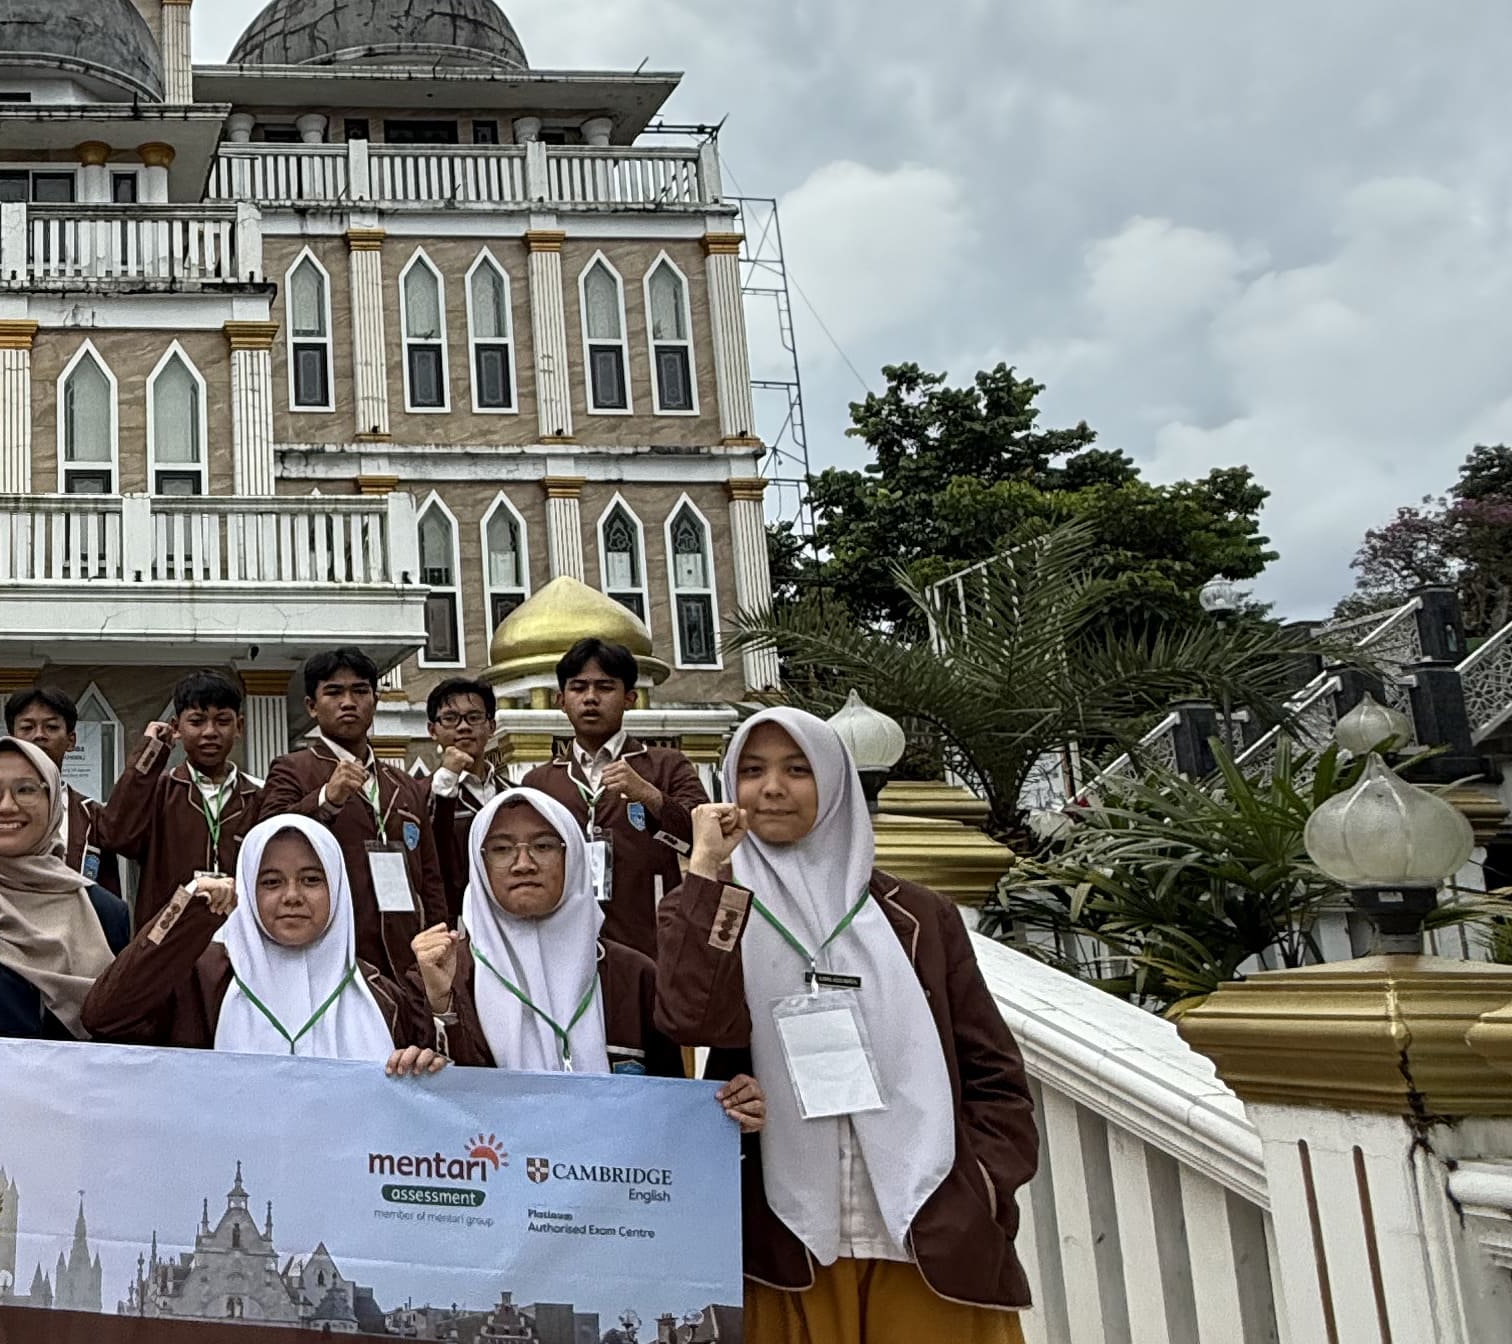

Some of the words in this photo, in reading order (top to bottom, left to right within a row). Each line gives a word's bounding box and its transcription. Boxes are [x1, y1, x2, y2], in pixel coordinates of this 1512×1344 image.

[369, 1152, 487, 1182] mentari
[553, 1163, 673, 1186] CAMBRIDGE
[391, 1188, 477, 1206] assessment
[628, 1188, 671, 1204] English
[528, 1209, 573, 1221] Platinum
[528, 1222, 587, 1235] Authorised
[589, 1224, 616, 1236] Exam
[619, 1226, 656, 1239] Centre
